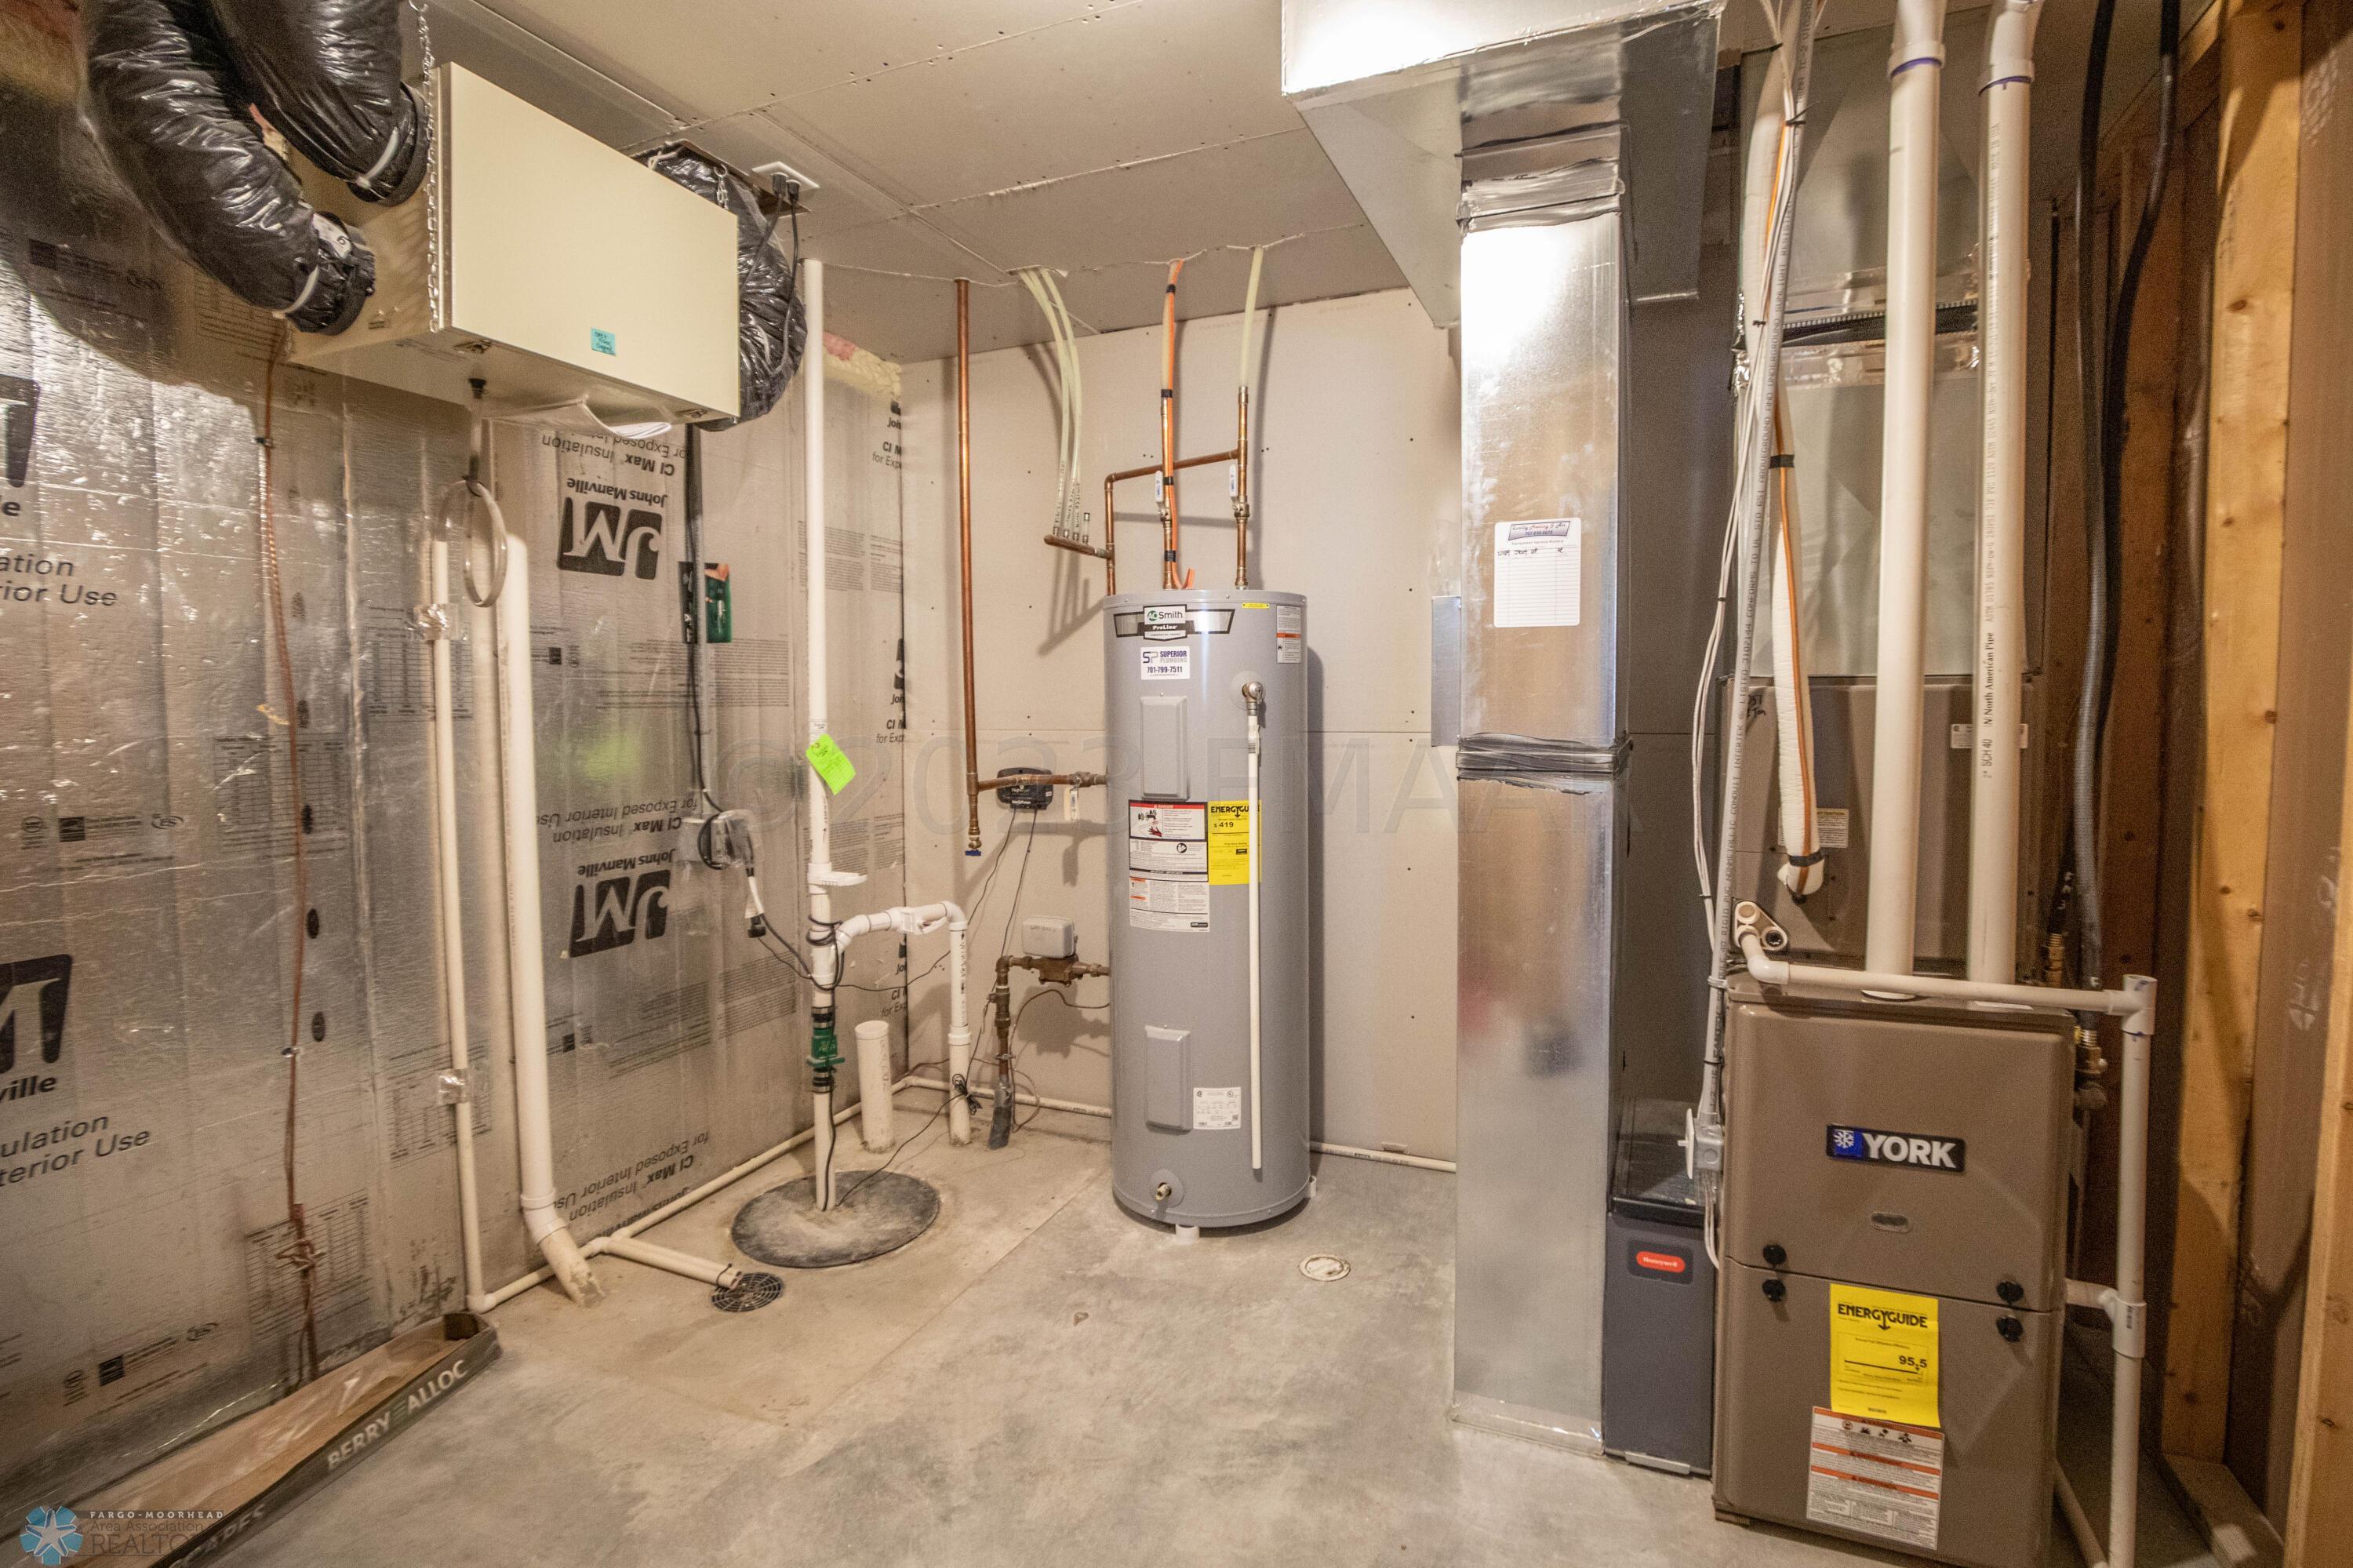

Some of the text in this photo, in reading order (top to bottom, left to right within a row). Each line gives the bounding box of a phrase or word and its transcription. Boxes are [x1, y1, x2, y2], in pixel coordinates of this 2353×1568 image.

[542, 435, 615, 464] Insulation
[660, 464, 675, 477] CI
[567, 478, 668, 508] Johns Manville
[556, 497, 663, 580] JM
[1750, 552, 1758, 566] TO
[0, 584, 118, 608] ior Use
[1745, 571, 1758, 618] CONFORMS
[1158, 610, 1184, 620] Smith
[1984, 632, 1995, 651] Pipe
[1147, 665, 1183, 674] 701-799-7511
[1984, 653, 1995, 691] American
[1983, 692, 1994, 715] North
[1981, 739, 1993, 749] 40
[1981, 750, 1993, 766] SCH
[622, 801, 678, 819] Exposed
[682, 797, 698, 811] for
[1210, 806, 1260, 818] ENERGYGU
[566, 809, 618, 824] Interior
[667, 817, 682, 830] CI
[553, 824, 624, 842] Insulation
[577, 848, 676, 878] Johns Manville
[569, 869, 671, 958] JM
[1720, 908, 1729, 937] RIGID
[94, 1129, 152, 1159] Use
[693, 1131, 708, 1146] for
[635, 1139, 689, 1172] Exposed
[1861, 1132, 1958, 1170] YORK
[679, 1154, 695, 1172] CI
[581, 1166, 632, 1199] Interior
[569, 1181, 637, 1221] Insulation
[1642, 1256, 1678, 1268] Honeywell
[1837, 1302, 1929, 1329] ENERGYGUIDE
[1898, 1355, 1928, 1369] 95.5
[326, 1359, 469, 1471] BERRY ALLOC
